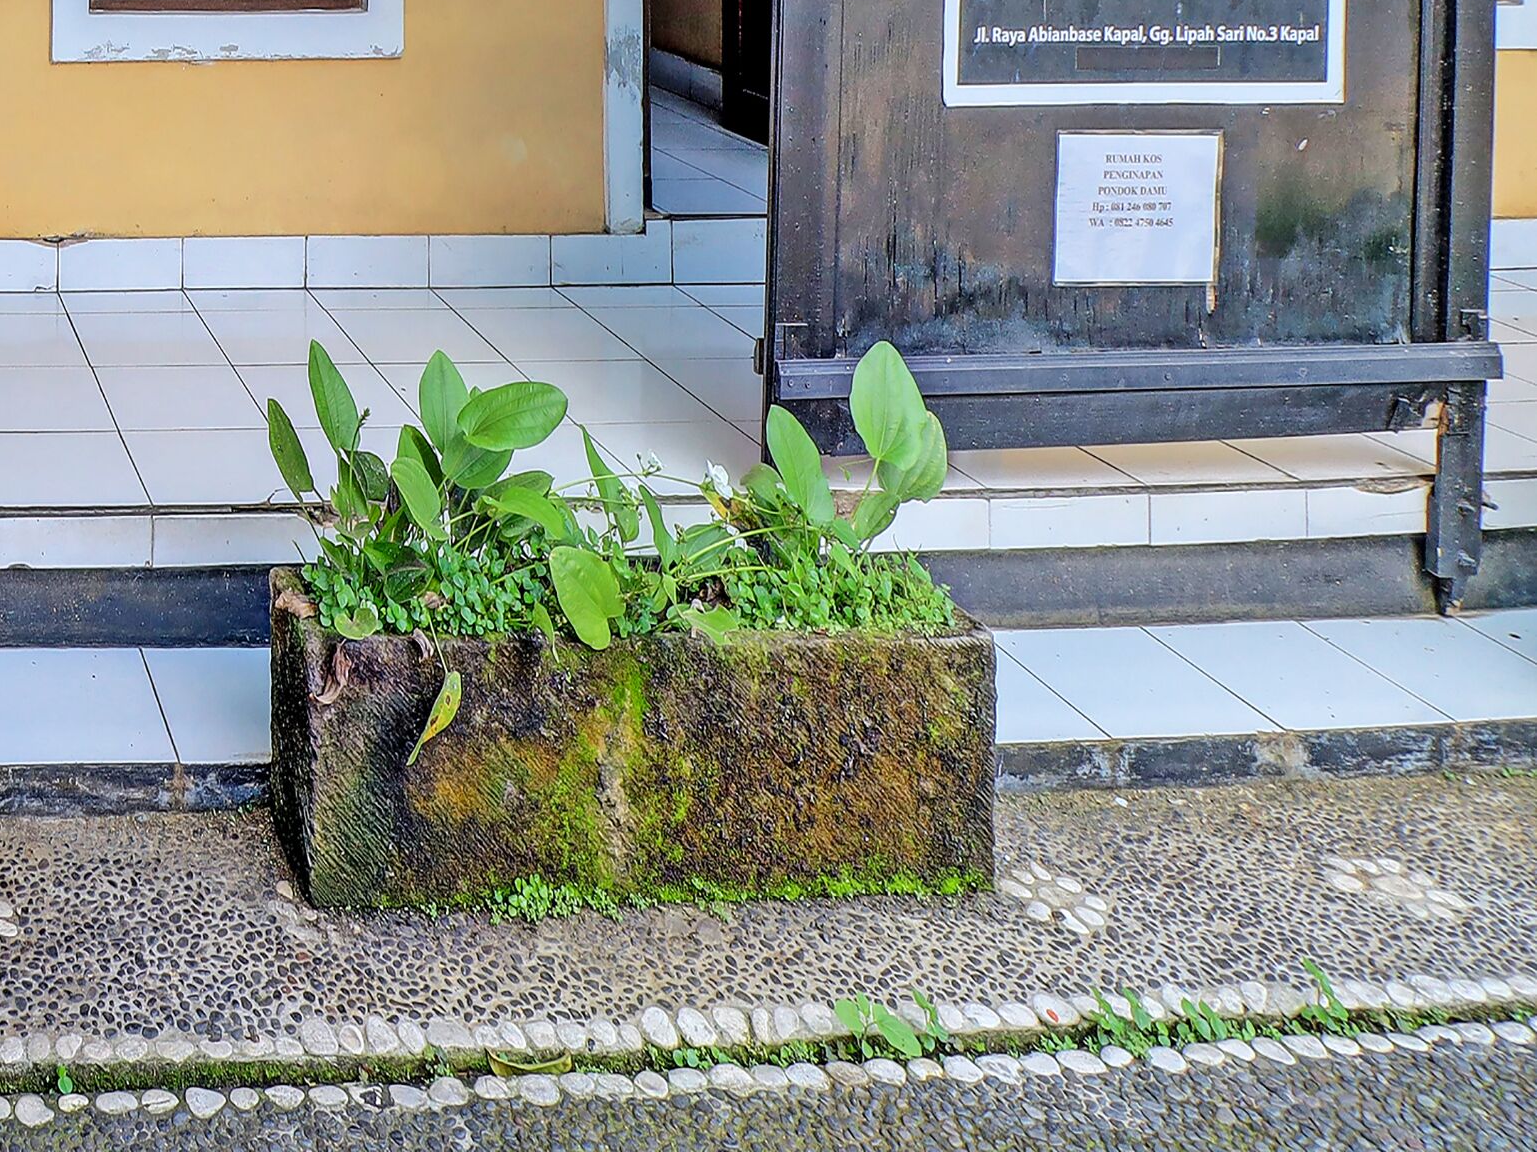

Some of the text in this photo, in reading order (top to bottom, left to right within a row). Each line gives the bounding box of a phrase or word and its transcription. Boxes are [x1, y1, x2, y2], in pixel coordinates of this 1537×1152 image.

[974, 25, 1320, 46] Jl. Raya Abianbase Kapal, Gg. Lipah Sari No.3 Kapal
[1106, 154, 1163, 163] RUMAH KOS
[1103, 170, 1163, 179] PENGINAPAN
[1098, 186, 1167, 196] PONDOK DAMU
[1089, 218, 1104, 227] WA
